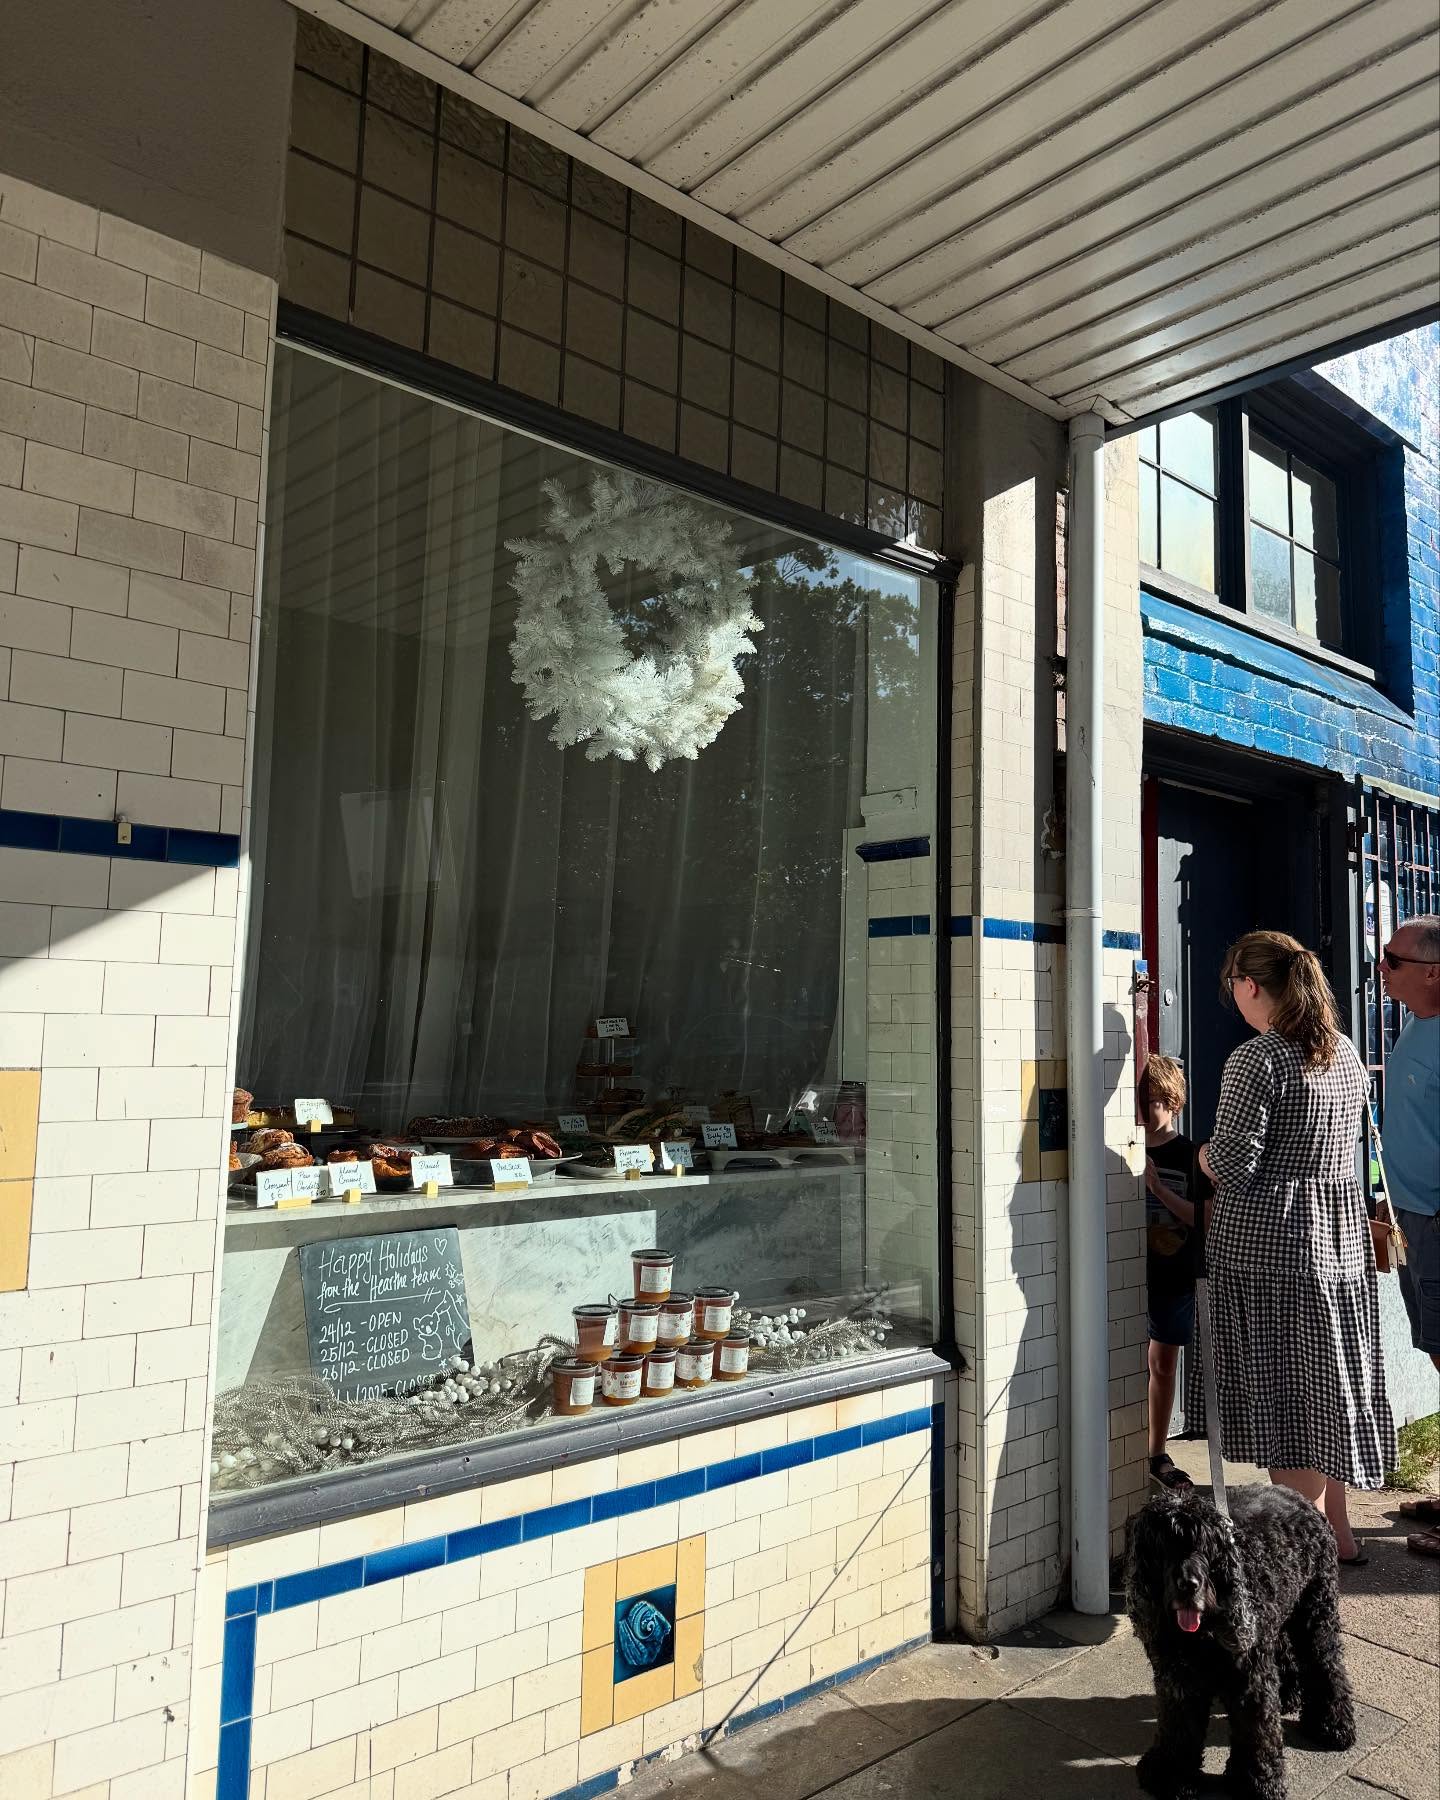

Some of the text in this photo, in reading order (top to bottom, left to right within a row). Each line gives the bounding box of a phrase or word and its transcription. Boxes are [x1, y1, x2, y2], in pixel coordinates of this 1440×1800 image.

[318, 1240, 429, 1284] Happy Holidays
[317, 1281, 341, 1311] from
[342, 1278, 359, 1299] the
[411, 1264, 442, 1288] team
[319, 1317, 357, 1345] 24/12
[320, 1340, 358, 1362] 25/12
[321, 1361, 360, 1383] 26/12
